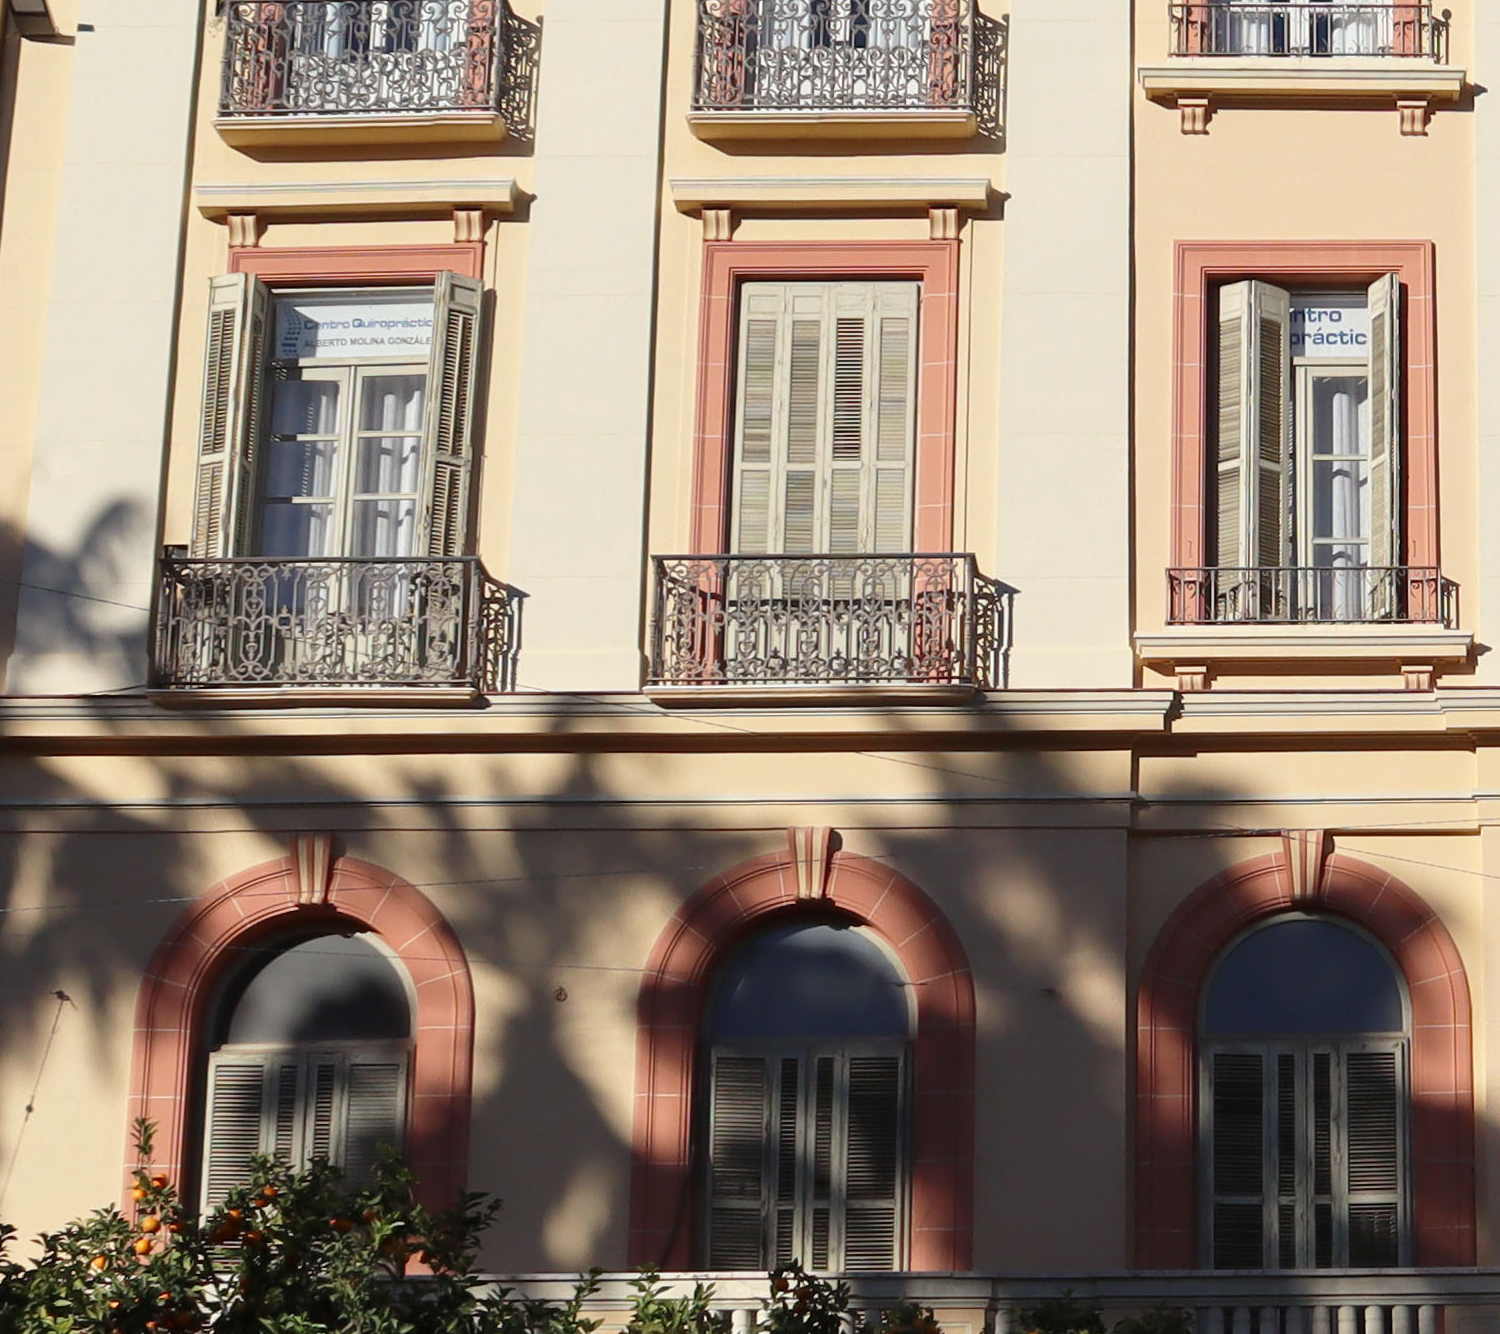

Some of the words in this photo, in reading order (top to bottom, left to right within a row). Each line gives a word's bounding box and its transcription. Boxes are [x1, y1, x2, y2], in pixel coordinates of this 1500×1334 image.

[1292, 308, 1342, 322] ntro
[304, 320, 350, 330] Centro
[352, 317, 433, 330] Quiropráctic
[305, 339, 347, 348] ALBERTO
[351, 337, 385, 346] MOLINA
[388, 335, 432, 345] GONZÁLE
[1290, 326, 1368, 348] práctic
